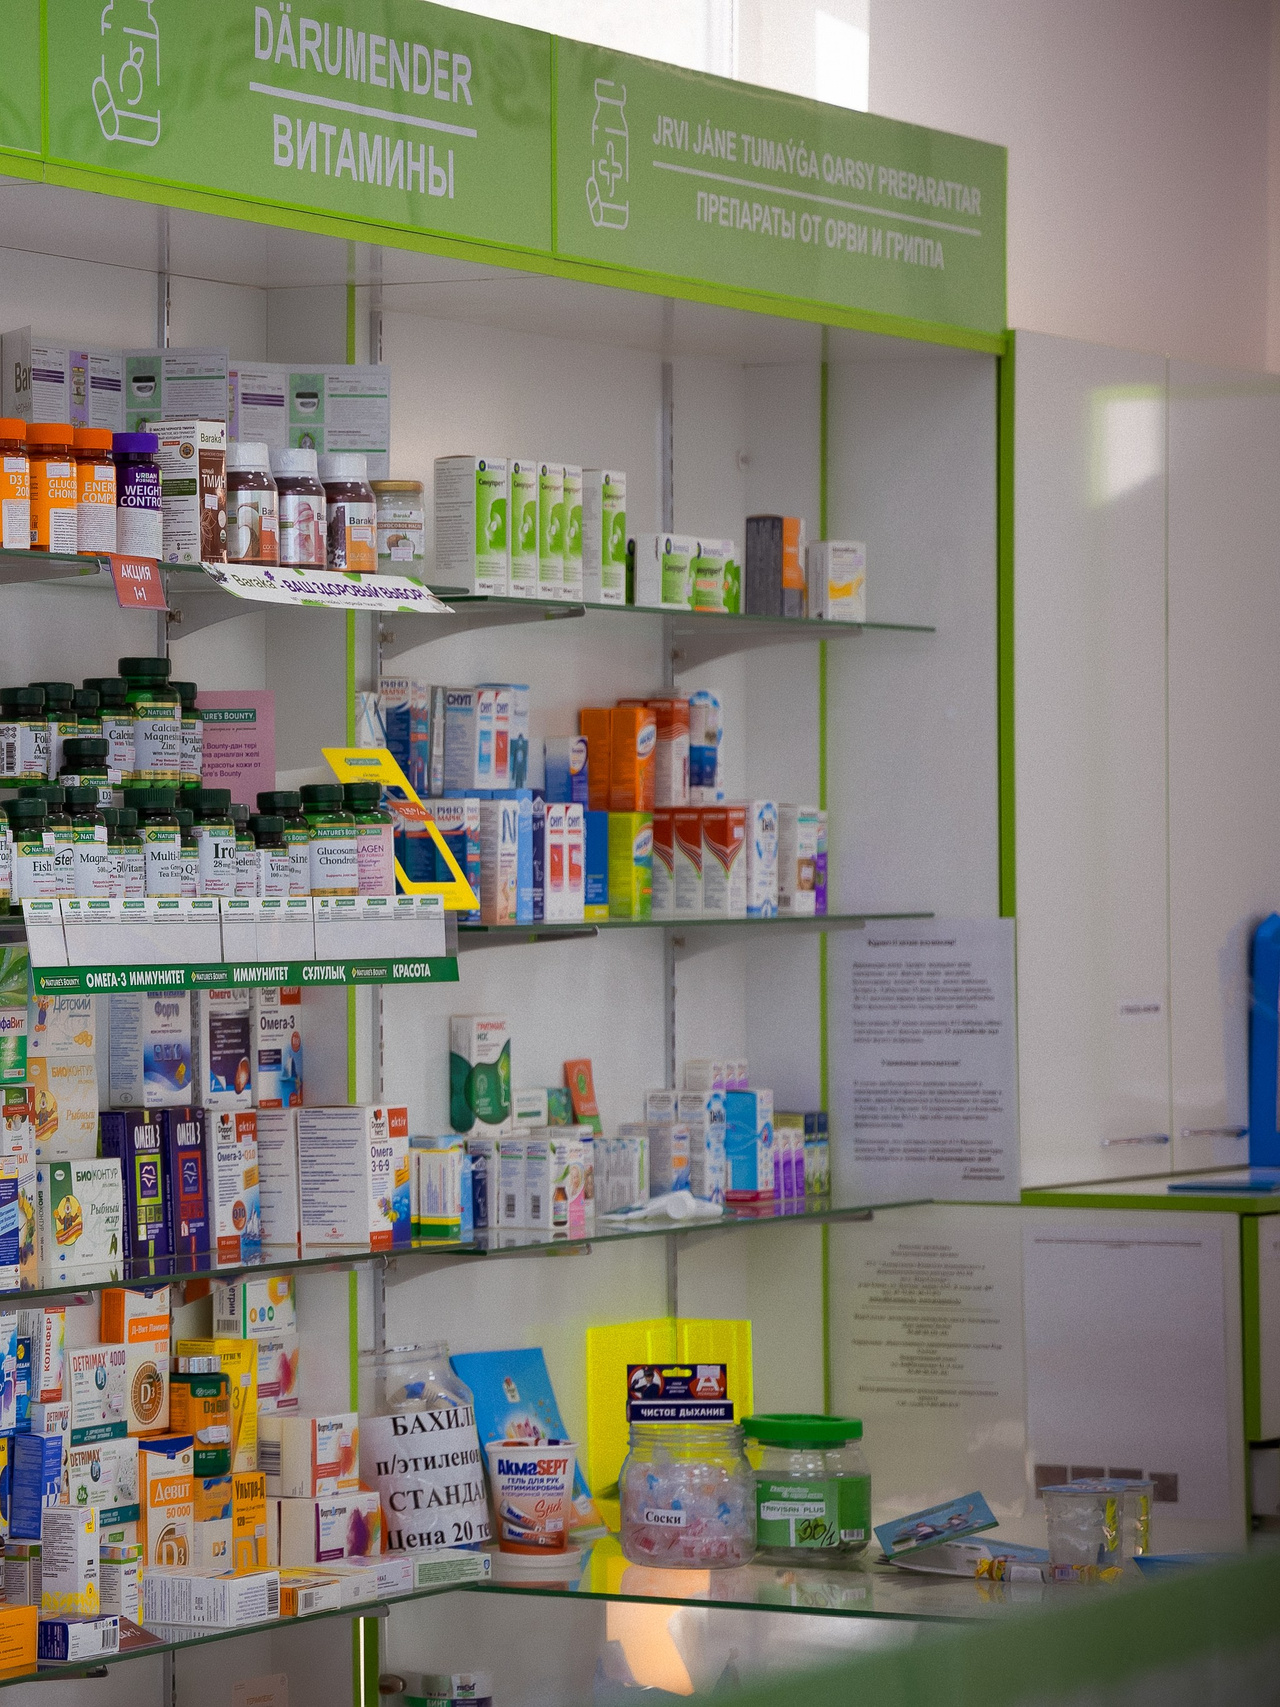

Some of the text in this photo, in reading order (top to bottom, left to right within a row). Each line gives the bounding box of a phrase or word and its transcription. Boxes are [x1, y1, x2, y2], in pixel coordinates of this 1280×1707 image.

[253, 3, 474, 107] DÄRUMENDER
[272, 113, 456, 200] ВИТАМИНЫ
[652, 115, 689, 151] JRVI
[693, 119, 737, 162] JÁNE
[822, 152, 874, 192] QARSY
[877, 166, 982, 217] PREPARATTAR
[696, 191, 945, 271] ПРЕПАРАТЫ ОТ ОРВИ И ГРИППА
[200, 433, 221, 443] Baraka
[121, 563, 152, 582] АКЦИЯ
[133, 586, 147, 601] 1+1
[317, 581, 380, 599] ЗДОРОВЫЙ
[436, 806, 464, 815] РИНО
[32, 860, 52, 872] Fish
[85, 969, 185, 988] ОМЕГА-3 ИММУНИТЕТ
[233, 965, 288, 981] ИММУНИТЕТ
[392, 962, 431, 979] КРАСОТА
[260, 1015, 296, 1031] Омега-3
[133, 1125, 154, 1149] ОМЕГА
[176, 1122, 195, 1146] ОМЕГА
[370, 1145, 393, 1158] Омега
[370, 1159, 390, 1173] 3-6-9
[89, 1203, 120, 1217] Рыбный
[104, 1215, 120, 1226] жир
[43, 1317, 52, 1372] КОЛЕФЕР
[72, 1349, 126, 1372] DETRIMAX 4000
[640, 1406, 726, 1418] ЧИСТОЕ ДЫХАНИЕ
[70, 1449, 101, 1467] DETRIMAX
[234, 1475, 265, 1502] Ультра-Д
[501, 1483, 565, 1491] АНТИМИКРОБНЫЙ
[527, 1477, 545, 1485] ДЛЯ
[154, 1481, 191, 1503] Девит
[388, 1479, 487, 1513] СТАНДА
[166, 1505, 191, 1519] 50 000
[534, 1499, 563, 1520] Stick
[645, 1510, 682, 1524] Соски
[236, 1516, 246, 1527] 120
[387, 1520, 473, 1553] Цена 20
